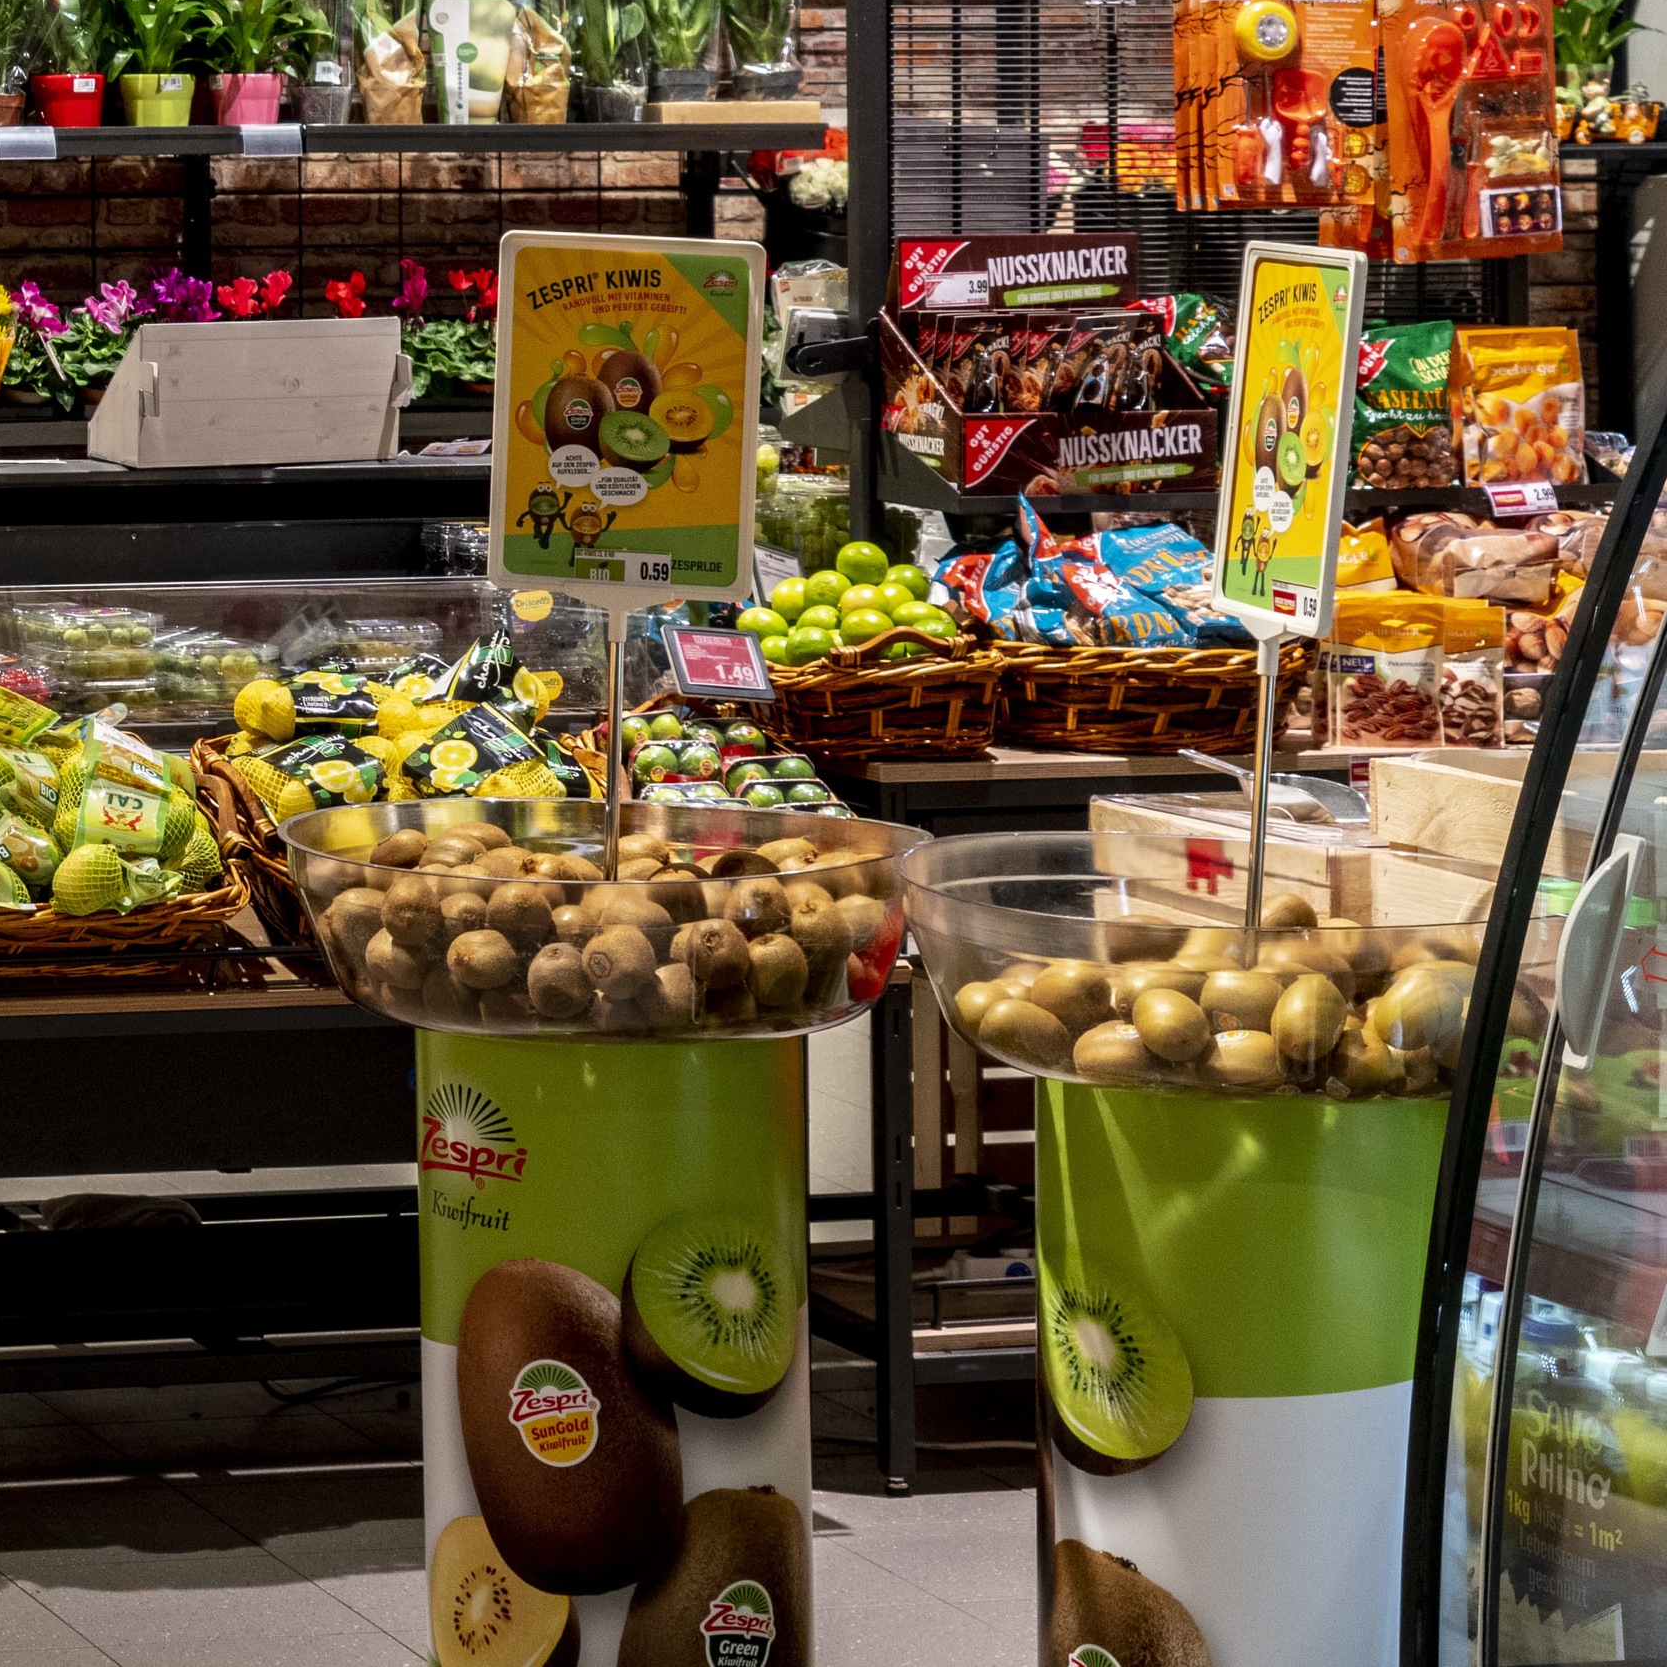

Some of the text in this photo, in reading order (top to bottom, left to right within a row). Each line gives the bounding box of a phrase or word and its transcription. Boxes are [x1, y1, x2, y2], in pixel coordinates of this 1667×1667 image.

[904, 246, 924, 270] GUT
[987, 245, 1129, 287] NUSSKNACKER
[605, 269, 662, 290] KIWIS
[908, 247, 948, 293] GÜNSTIG
[969, 279, 988, 294] 3.99
[1293, 283, 1317, 304] KIWIS
[562, 293, 670, 312] RANDVOLL MIT VITAMINEN
[592, 304, 687, 315] UND PERFEKT GEREIFT!
[1420, 366, 1450, 384] SCHA
[970, 424, 990, 448] GUT
[982, 439, 992, 449] &
[1058, 424, 1204, 468] NUSSKNACKER
[972, 425, 1014, 472] GÜNSTIG
[1533, 487, 1555, 502] 2.99
[640, 562, 669, 581] 0.59
[671, 560, 723, 573] ZESPRI.DE
[1303, 596, 1317, 618] 0.59
[715, 663, 755, 682] 1.49
[1342, 658, 1367, 668] NEU
[132, 761, 157, 779] BIO
[40, 782, 57, 802] BIO
[420, 1115, 529, 1181] Zespri
[430, 1188, 511, 1232] Kiwifruit
[512, 1388, 589, 1421] Zespri
[530, 1417, 590, 1441] SunGold
[538, 1434, 587, 1454] Kiwifruit
[1507, 1489, 1531, 1526] 1kg
[1519, 1528, 1595, 1579] Lebensraum
[703, 1603, 773, 1638] Zespri
[718, 1638, 759, 1657] Green
